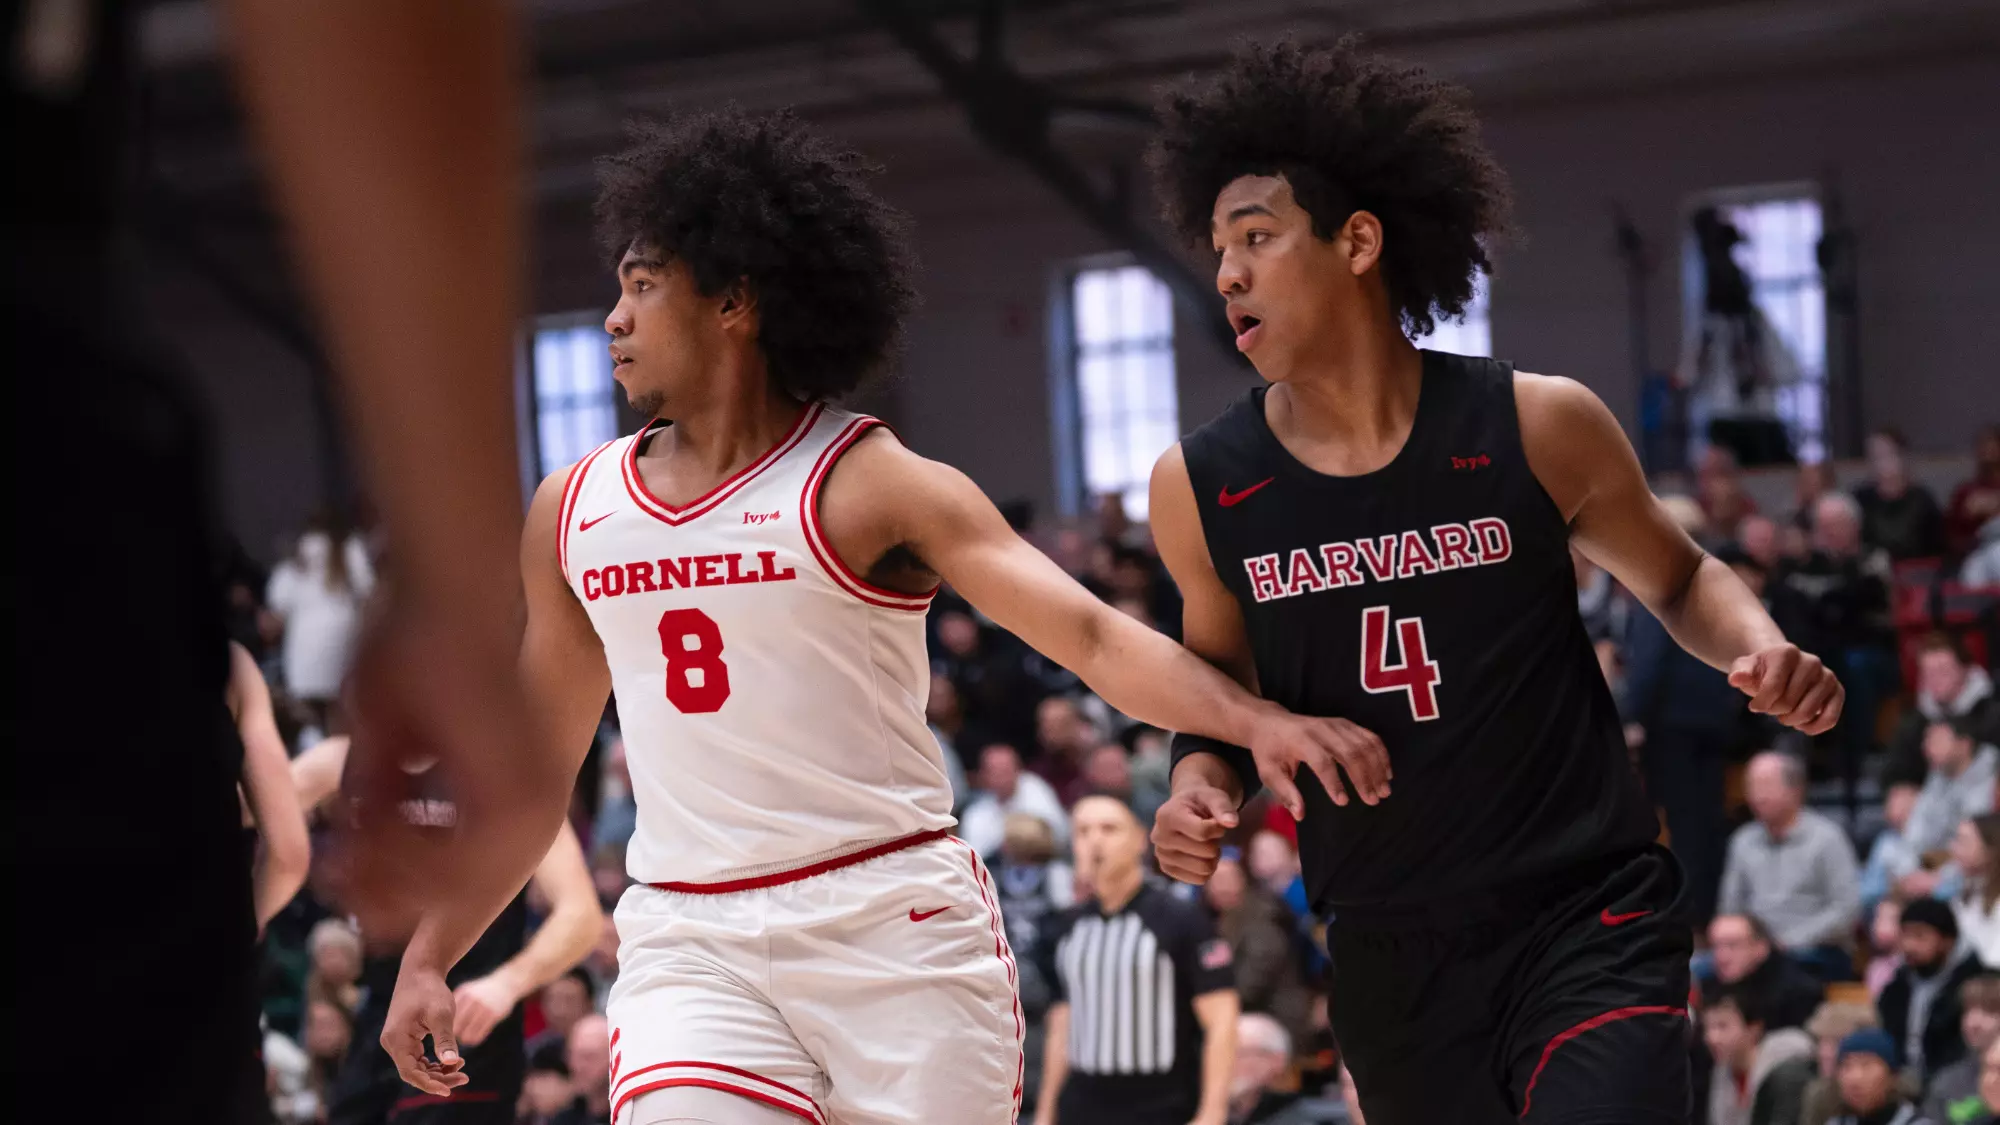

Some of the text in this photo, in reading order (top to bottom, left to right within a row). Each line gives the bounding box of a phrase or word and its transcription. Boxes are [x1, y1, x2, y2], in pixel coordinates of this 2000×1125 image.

[742, 511, 769, 526] Ivy
[1243, 516, 1512, 602] HARVARD
[582, 550, 797, 602] CORNELL
[657, 607, 731, 714] 8
[1360, 605, 1441, 722] 4
